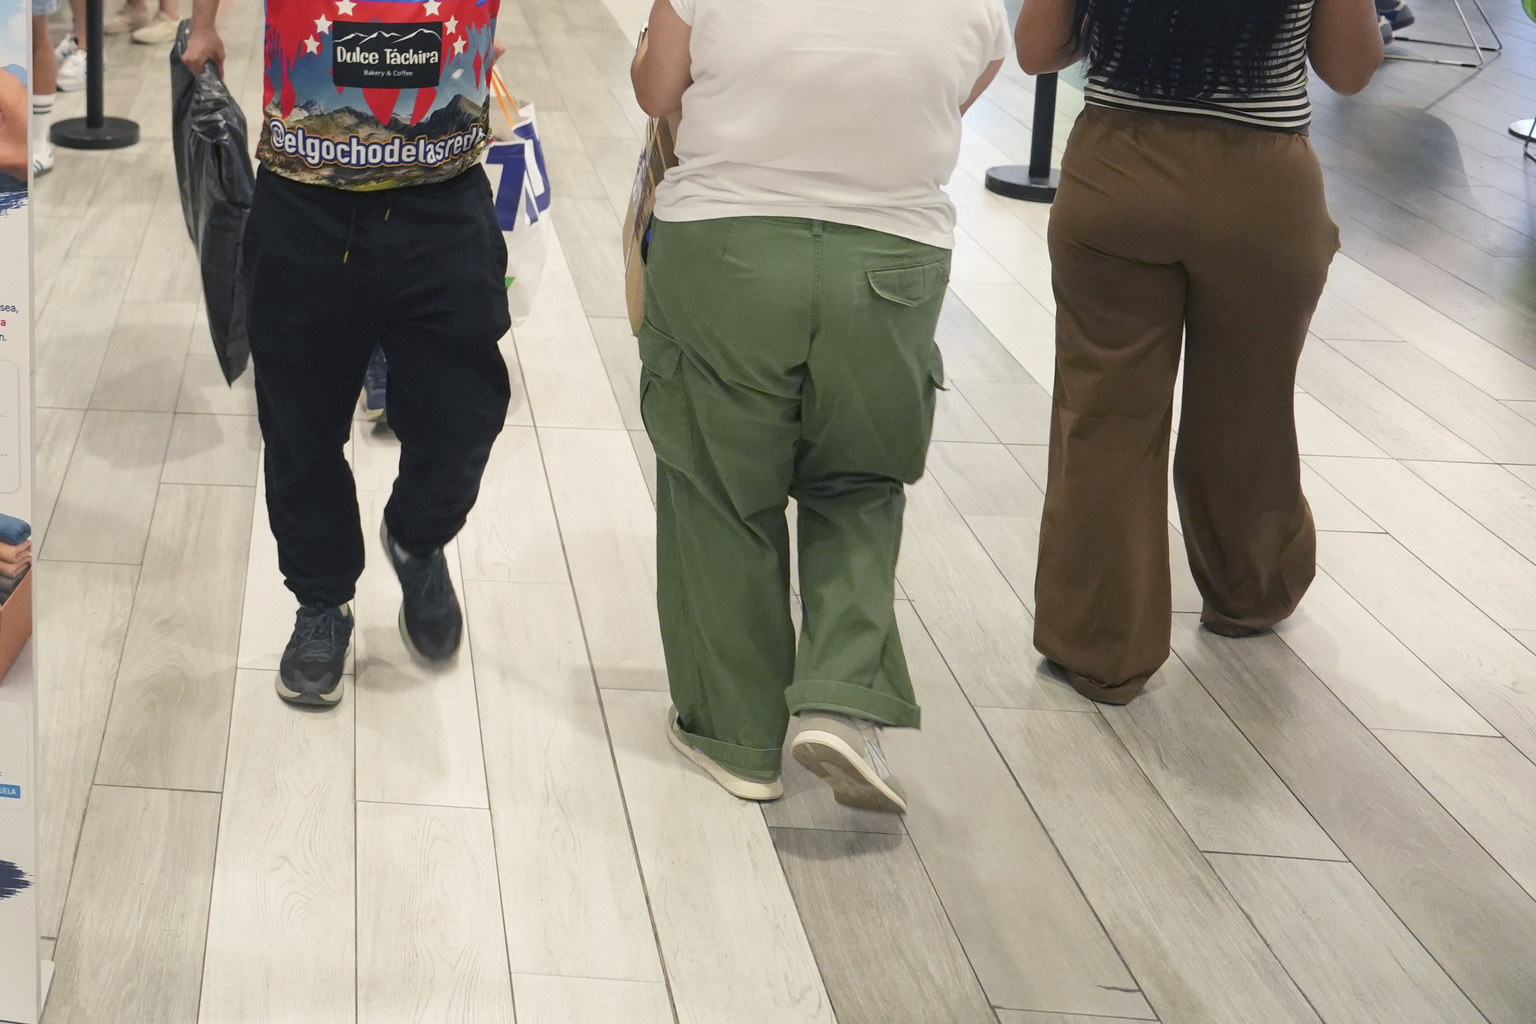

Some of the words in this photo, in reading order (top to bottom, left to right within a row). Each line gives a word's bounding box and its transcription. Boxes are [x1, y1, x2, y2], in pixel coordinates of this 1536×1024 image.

[336, 46, 379, 64] Dulce
[384, 47, 438, 65] Táchira
[364, 69, 386, 78] Bakery
